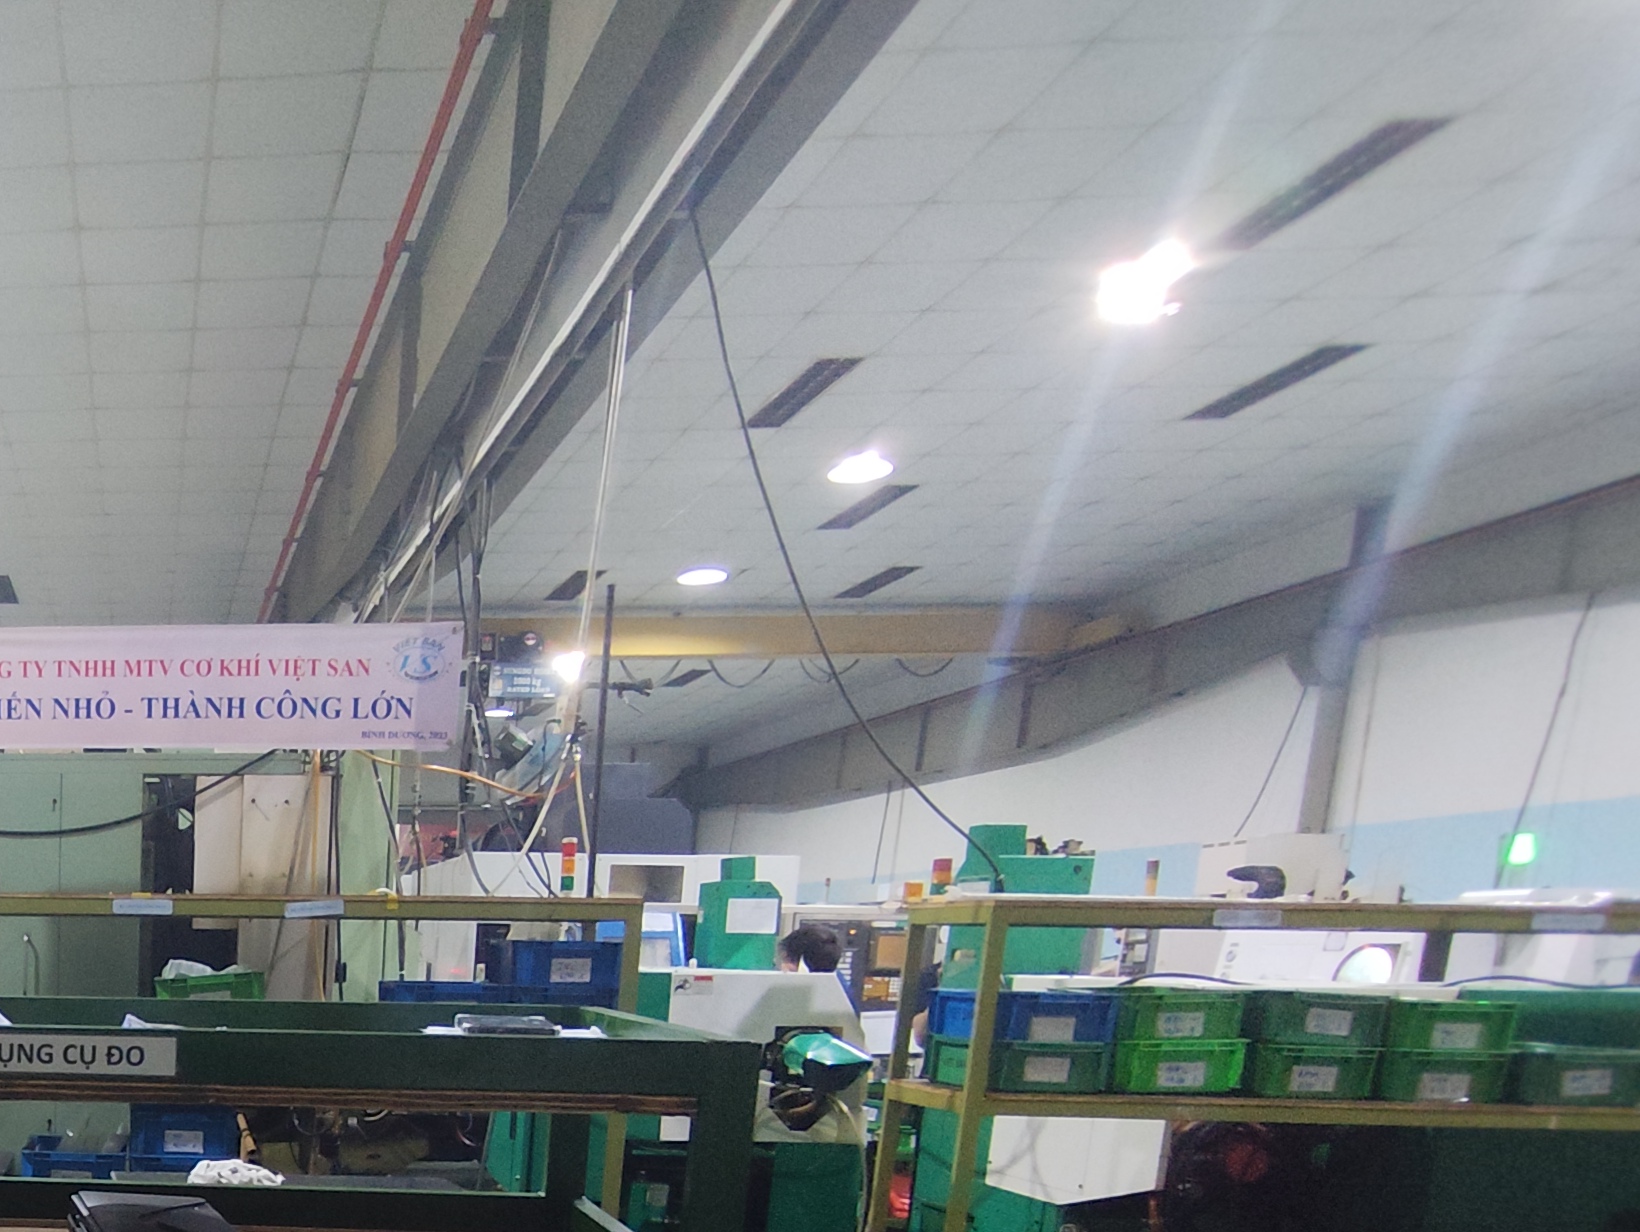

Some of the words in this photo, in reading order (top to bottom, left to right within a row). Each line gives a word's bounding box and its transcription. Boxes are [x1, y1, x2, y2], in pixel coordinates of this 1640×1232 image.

[19, 660, 47, 678] TY
[53, 660, 116, 678] TNHH
[123, 659, 175, 678] MTV
[179, 657, 213, 678] CƠ
[219, 653, 260, 678] KHÍ
[267, 655, 321, 682] VIỆT
[327, 659, 371, 678] SAN
[51, 690, 116, 720] NHỎ
[141, 689, 245, 720] THÀNH
[255, 689, 342, 720] CÔNG
[351, 689, 414, 720] LỚN
[63, 1044, 96, 1070] CỤ
[106, 1045, 145, 1067] ĐO
